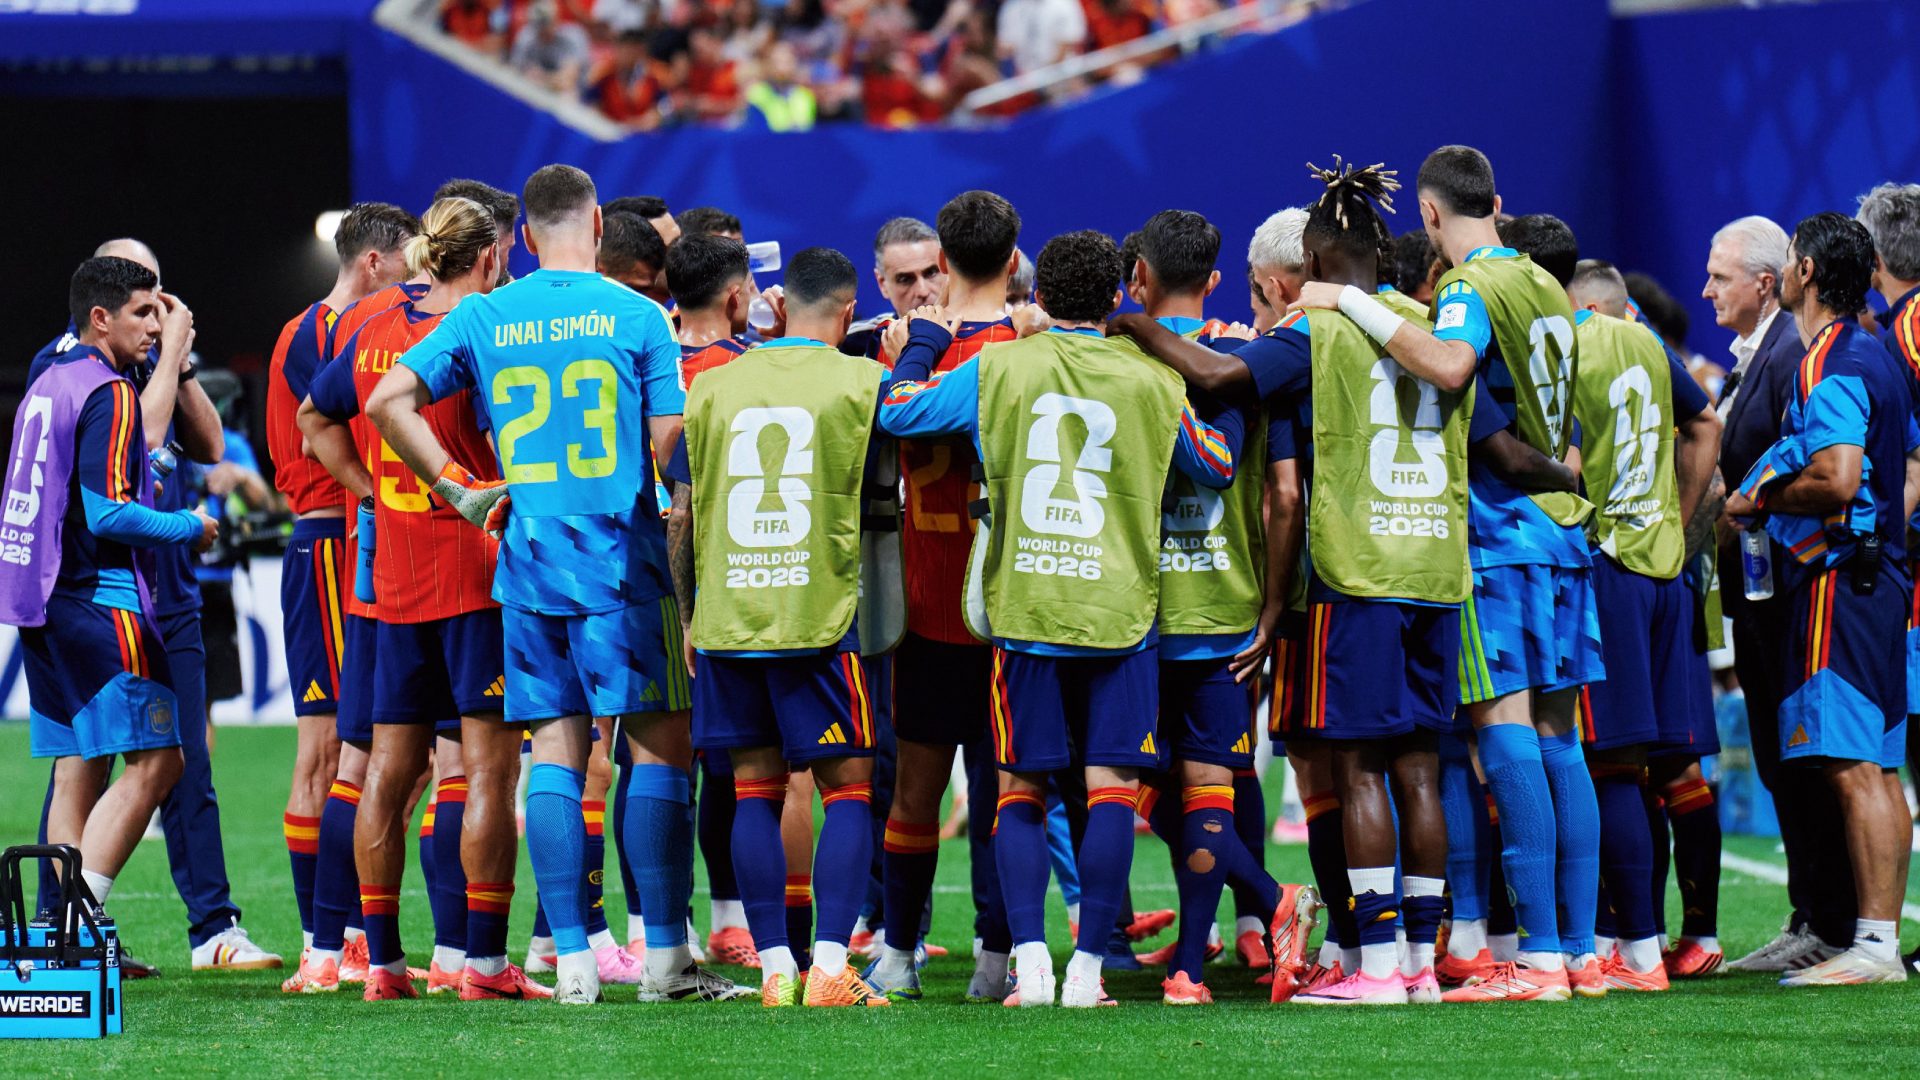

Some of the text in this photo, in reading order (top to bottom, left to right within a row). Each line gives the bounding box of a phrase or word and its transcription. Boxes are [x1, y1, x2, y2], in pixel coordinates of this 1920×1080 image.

[495, 309, 616, 347] UNAI SIMÓN
[355, 349, 368, 373] M.
[492, 359, 618, 484] 23
[1391, 470, 1429, 485] FIFA
[9, 498, 30, 514] IFA
[1045, 506, 1083, 525] FIFA
[1370, 500, 1449, 517] WORLD CUP
[1603, 501, 1639, 515] ORLD
[753, 519, 790, 534] FIFA
[1369, 515, 1449, 539] 2026
[1017, 536, 1103, 558] WORLD CUP
[1163, 536, 1228, 550] ORLD CUP
[0, 541, 32, 566] 26
[727, 551, 811, 566] WORLD CUP
[1014, 552, 1103, 581] 2026
[725, 566, 810, 588] 2026
[0, 996, 84, 1013] WERADE
